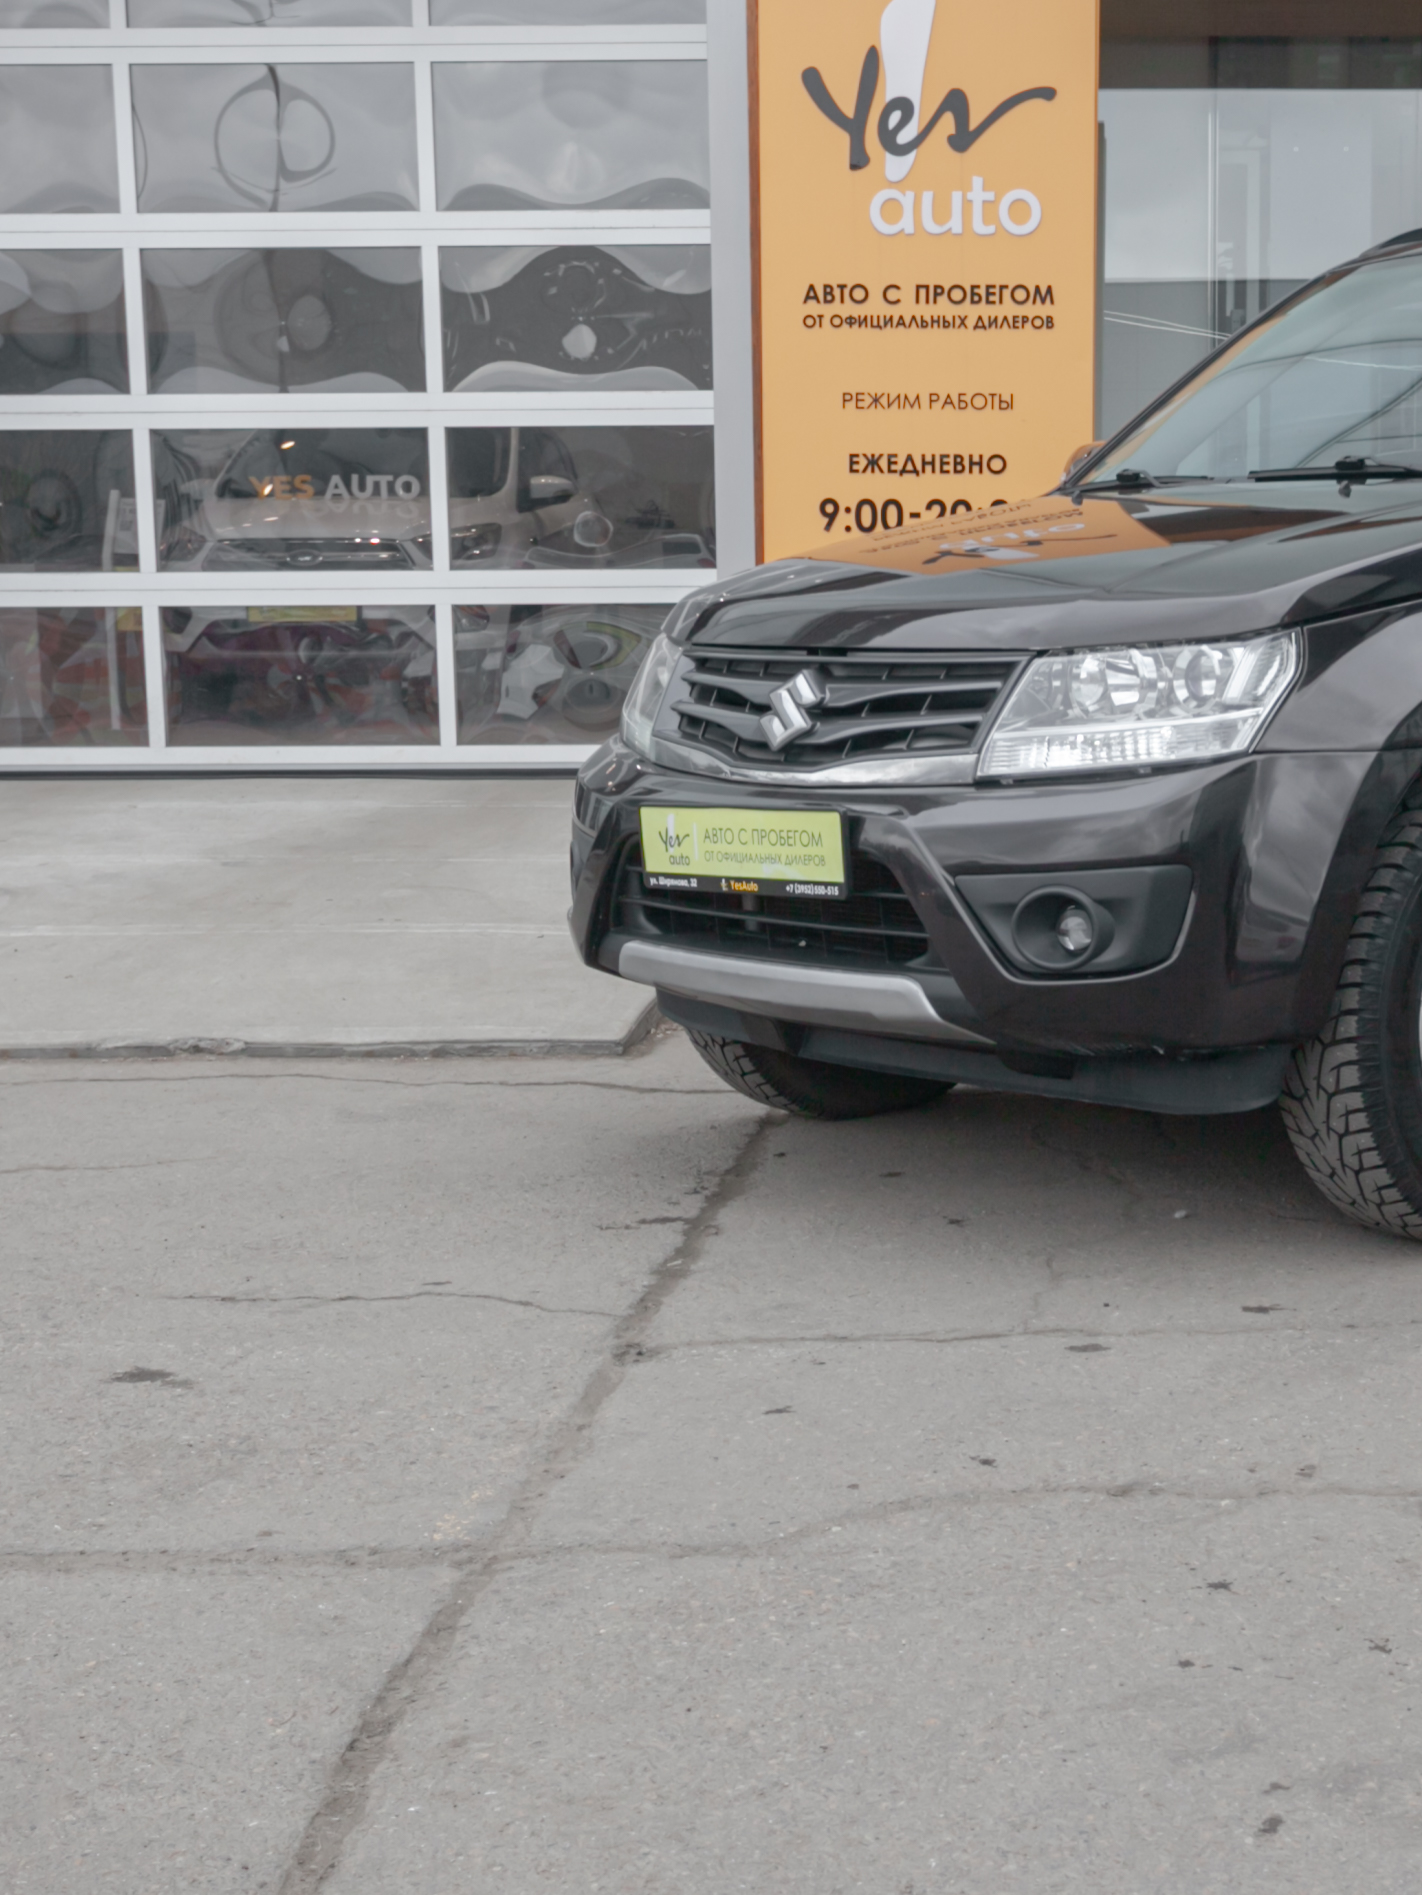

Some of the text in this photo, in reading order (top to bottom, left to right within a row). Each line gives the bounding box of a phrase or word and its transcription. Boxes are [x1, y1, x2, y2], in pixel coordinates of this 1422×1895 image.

[869, 176, 1042, 237] auto
[803, 284, 1055, 306] АВТО С ПРОБЕГОМ
[803, 314, 1055, 331] ОТ ОФИЦИАЛЬНЫХ ДИЛЕРОВ
[842, 392, 1014, 410] РЕЖИМ РАБОТЫ
[849, 454, 1007, 476] ЕЖЕДНЕВНО
[248, 474, 420, 500] YES AUTO
[703, 828, 824, 848] АВТО С ПРОБЕГОМ
[669, 853, 691, 866] auto
[704, 850, 826, 867] ОТ ОФИЦИАЛЬНЫХ ДИЛЕРОВ
[729, 879, 759, 893] YesAuto
